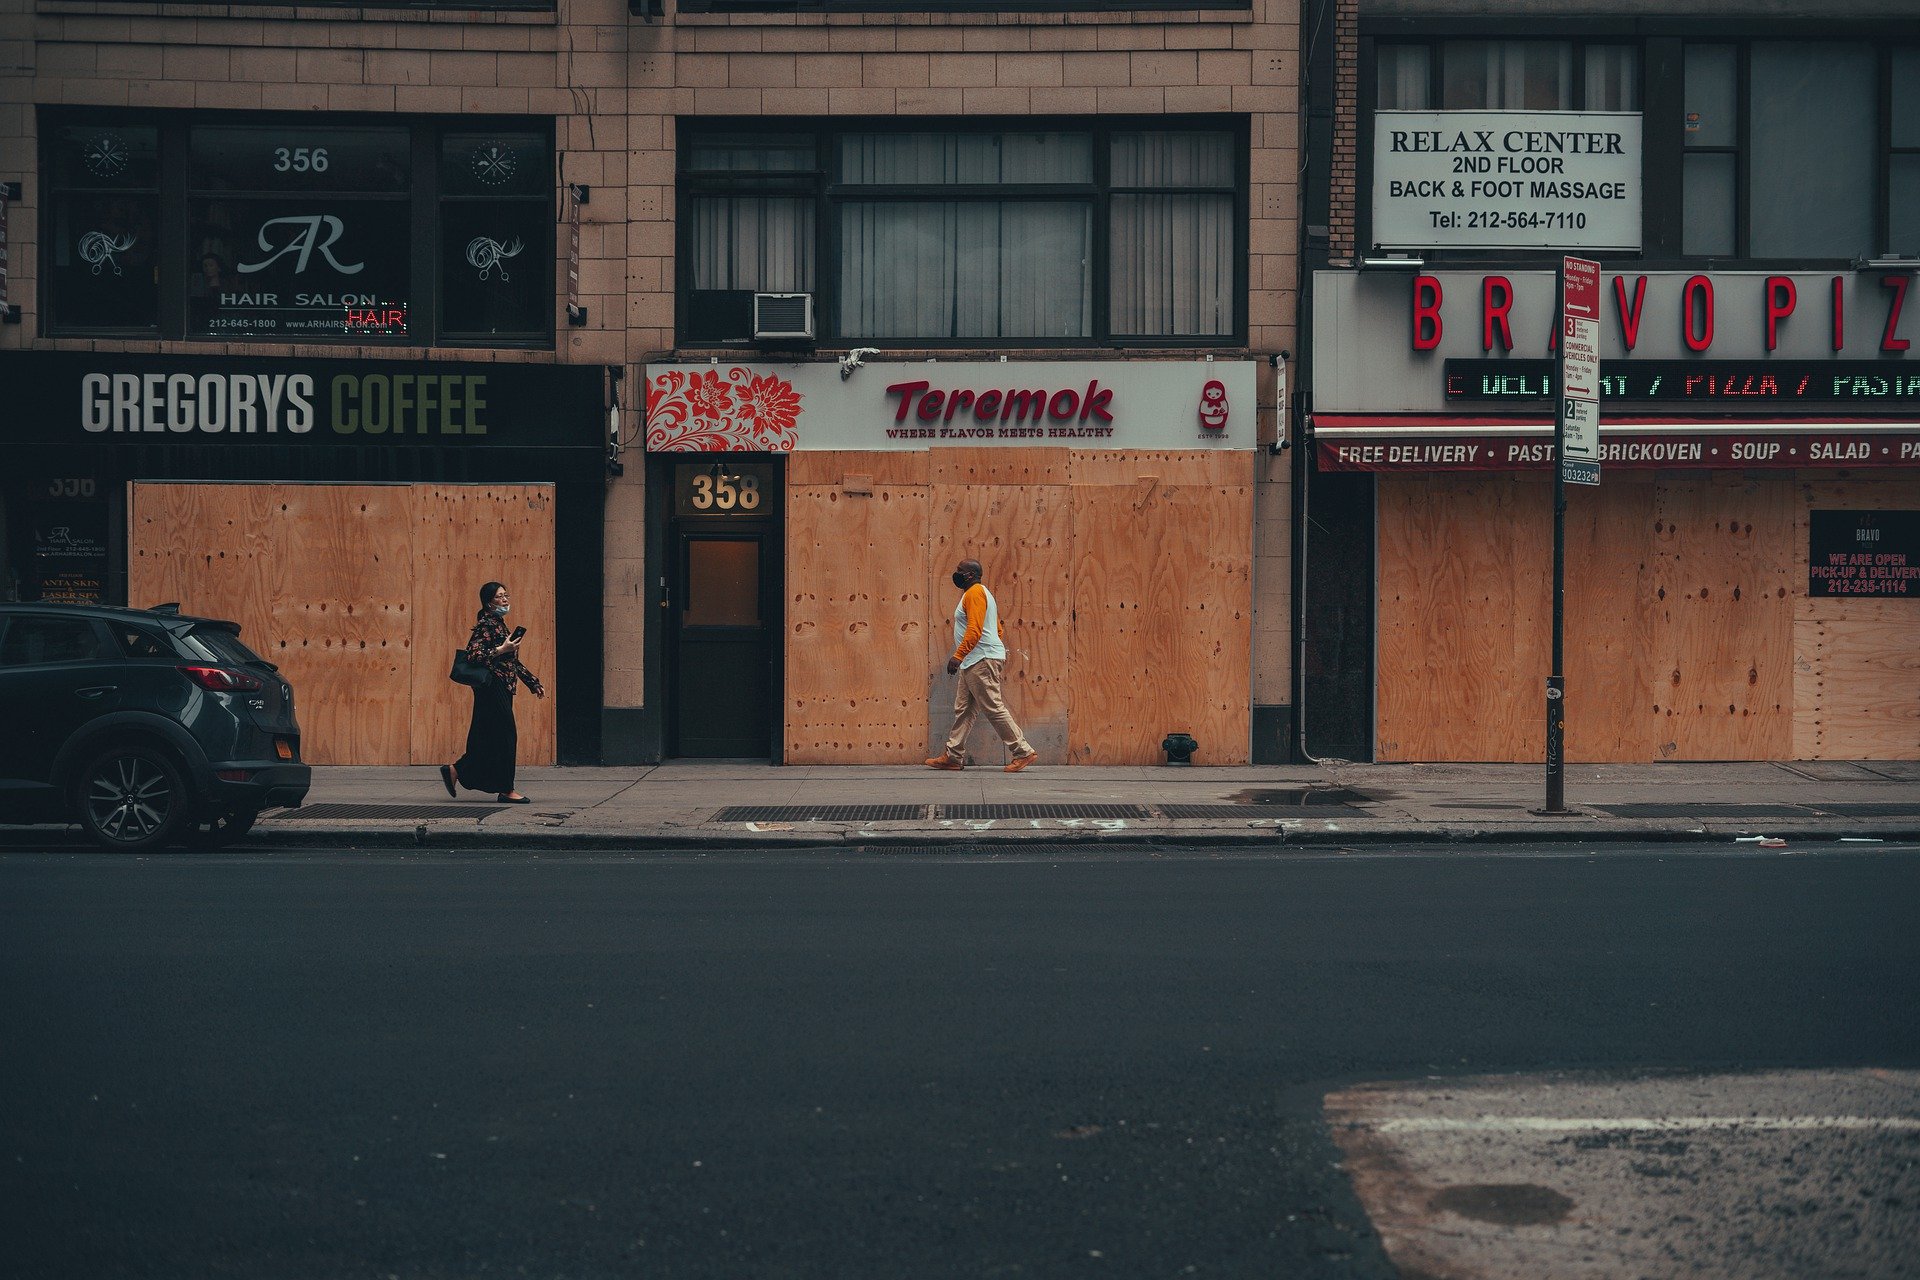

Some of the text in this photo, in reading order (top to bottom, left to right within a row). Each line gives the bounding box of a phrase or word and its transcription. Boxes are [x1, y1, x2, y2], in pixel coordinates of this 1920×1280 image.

[1390, 131, 1625, 154] RELAX CENTER
[273, 147, 329, 172] 356
[1453, 156, 1564, 174] 2ND FLOOR
[1390, 180, 1626, 200] BACK & FOOT MASSAGE
[1429, 211, 1586, 229] Tel: 212-564-7110
[1566, 261, 1595, 274] NO STANDING
[220, 293, 377, 306] HAIR SALON
[208, 319, 276, 328] 212-645-1800
[347, 309, 405, 326] HAIR
[1567, 317, 1574, 335] 3
[1565, 341, 1593, 353] COMMERCIAL
[1587, 354, 1598, 364] ONLY
[1685, 375, 1779, 395] PIZZA
[81, 373, 488, 435] GREGORYS COFFEE
[886, 379, 1114, 422] Teremok
[1566, 400, 1573, 418] 2
[886, 428, 1114, 439] WHERE FLAVOR MEETS HEALTHY
[1338, 445, 1384, 463] FREE
[1388, 445, 1479, 462] DELIVERY
[1507, 444, 1556, 462] PAST
[1598, 442, 1702, 461] BRICKOVEN
[1731, 442, 1781, 460] SOUP
[1809, 442, 1871, 460] SALAD
[692, 474, 760, 510] 358
[1856, 529, 1880, 541] BRAVO
[1828, 553, 1906, 566] WE ARE OPEN
[1811, 566, 1857, 578] PICK-UP
[1859, 567, 1867, 578] &
[73, 579, 100, 587] SKIN
[1828, 579, 1907, 593] 212-235-1114
